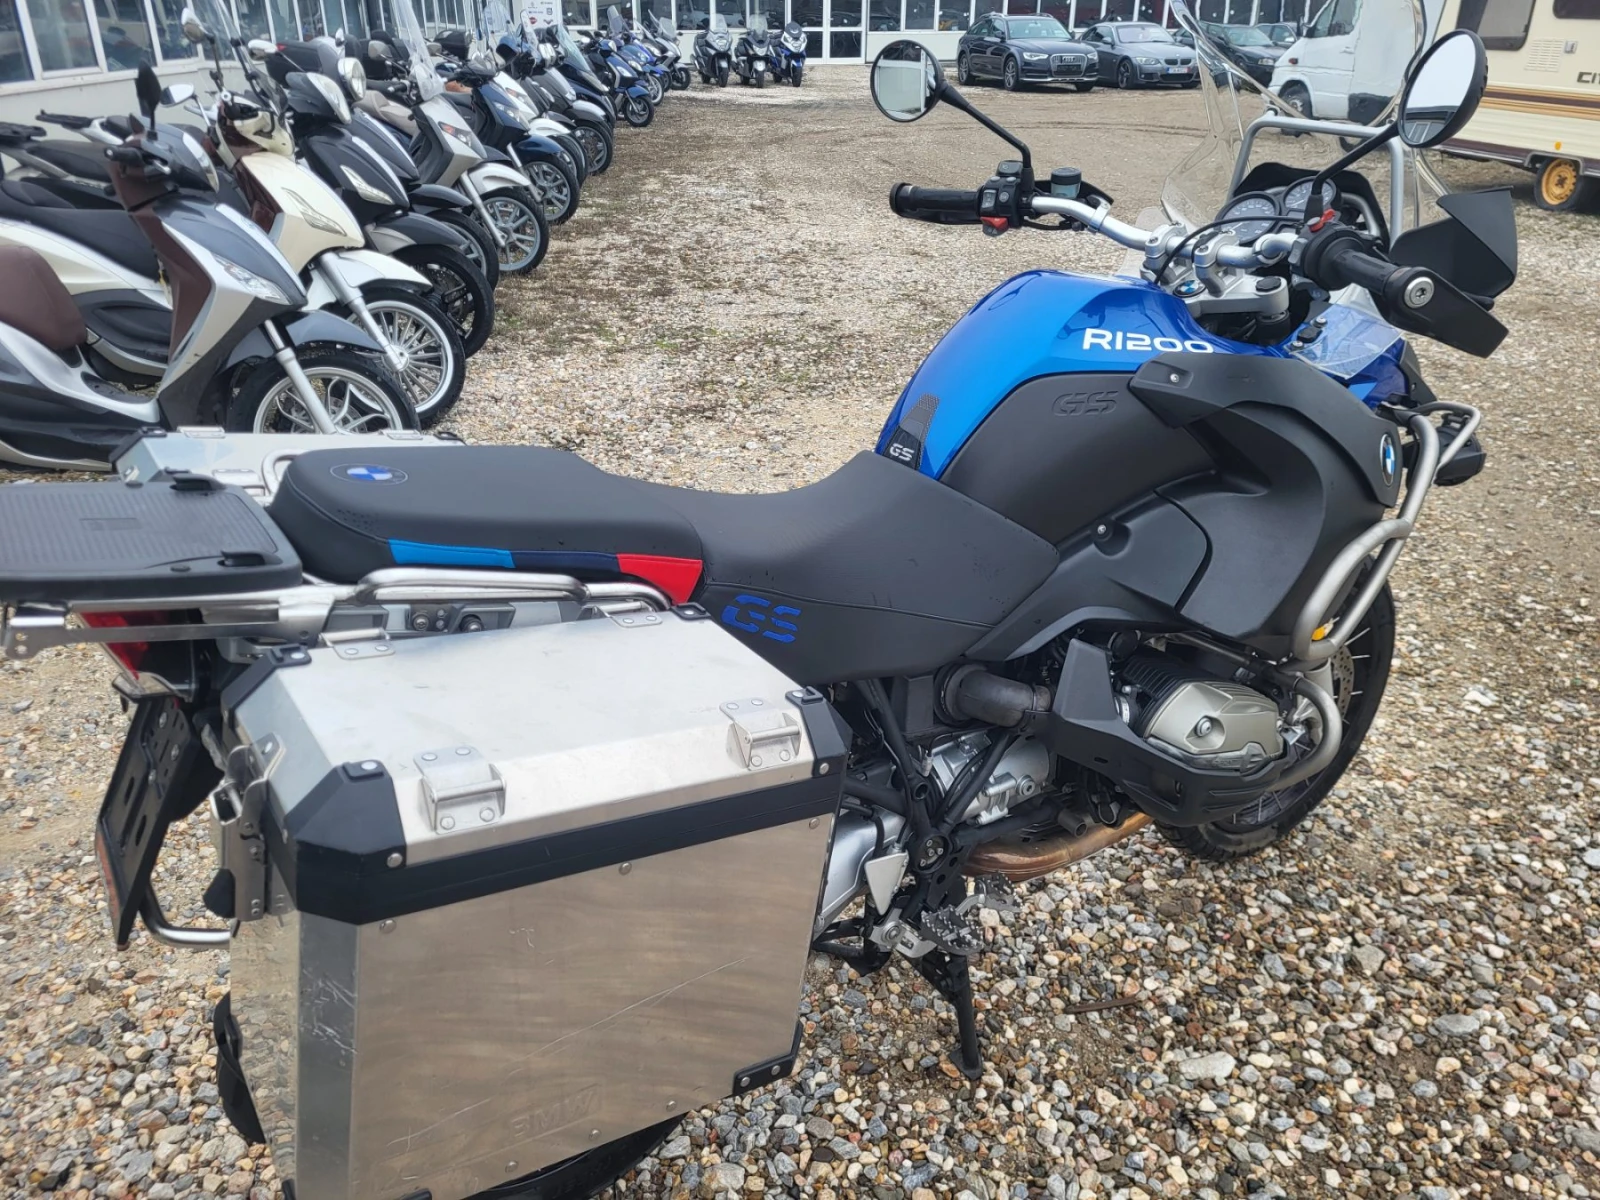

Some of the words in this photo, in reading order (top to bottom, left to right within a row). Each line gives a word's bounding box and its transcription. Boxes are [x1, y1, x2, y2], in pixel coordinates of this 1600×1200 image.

[1577, 71, 1600, 85] CI
[1082, 328, 1214, 354] R1200
[1052, 391, 1119, 417] GS
[889, 442, 915, 462] GS
[720, 594, 801, 643] GS
[510, 1086, 597, 1137] BMW
